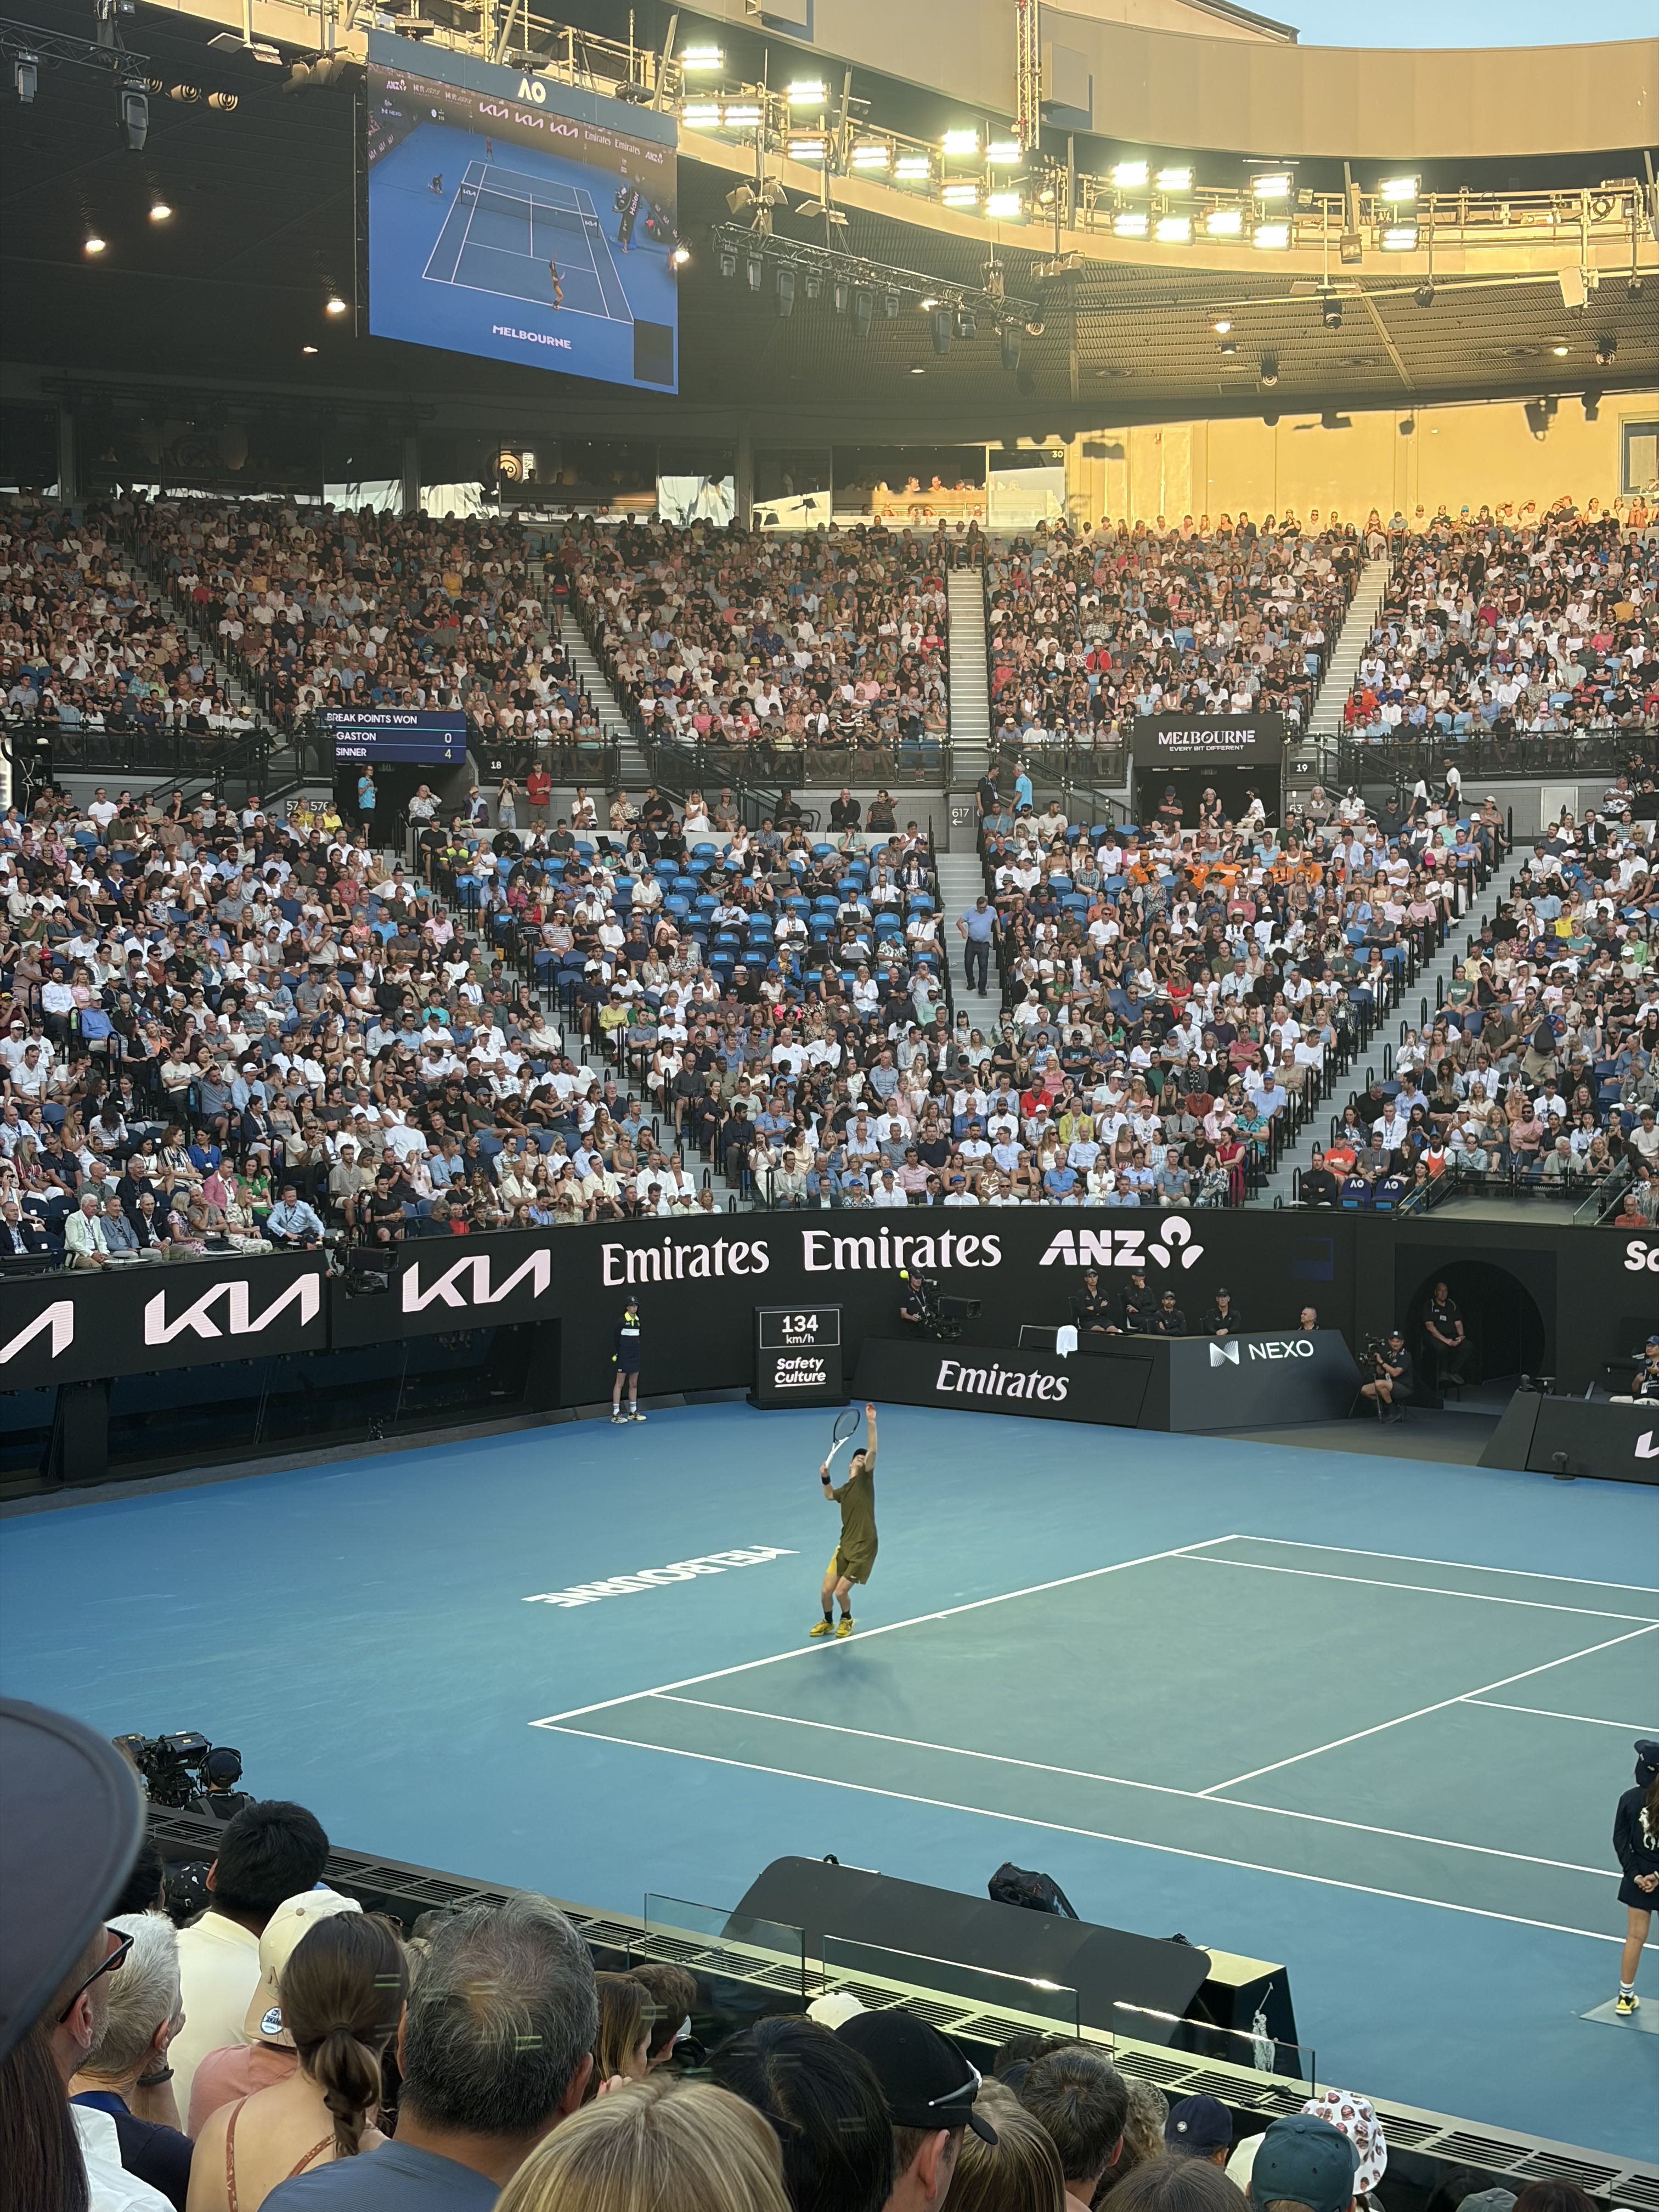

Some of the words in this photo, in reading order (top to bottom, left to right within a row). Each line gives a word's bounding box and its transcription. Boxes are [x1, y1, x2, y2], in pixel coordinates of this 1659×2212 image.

[518, 78, 546, 103] AO
[585, 130, 611, 146] Emirates
[615, 138, 640, 155] Emirates
[493, 325, 572, 349] MELBOURNE
[327, 713, 356, 723] BREAK
[358, 714, 391, 724] POINTS
[393, 715, 417, 724] WON
[336, 732, 376, 741] GASTON
[445, 733, 452, 743] 0
[1158, 730, 1256, 745] MELBOURNE
[336, 748, 367, 757] SINNER
[445, 749, 452, 759] 4
[1296, 764, 1308, 772] 19
[286, 801, 299, 810] 57
[952, 808, 969, 817] 617
[1289, 804, 1303, 813] 63
[1350, 1180, 1364, 1188] AO
[1384, 1181, 1398, 1189] AO
[802, 1227, 1002, 1271] Emirates
[1039, 1229, 1146, 1266] ANZ
[601, 1236, 769, 1286] Emirates
[782, 1314, 819, 1333] 134
[786, 1333, 815, 1344] km/h
[1248, 1340, 1314, 1361] NEXO
[776, 1357, 824, 1372] Safety
[774, 1369, 826, 1384] Culture
[936, 1359, 1069, 1401] Emirates
[521, 1545, 801, 1607] MELBOURNE
